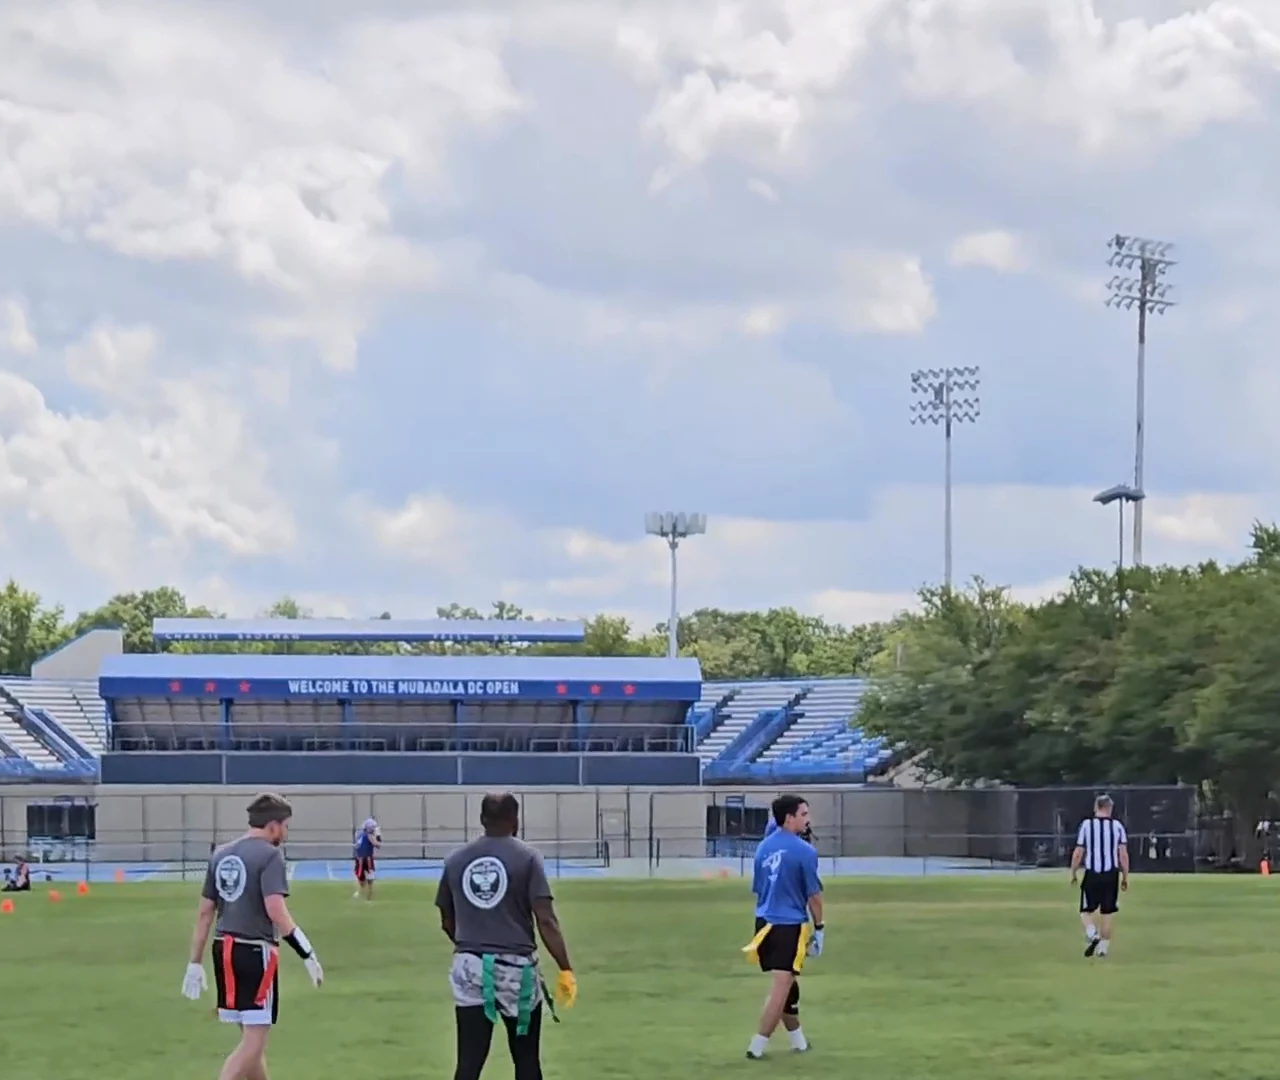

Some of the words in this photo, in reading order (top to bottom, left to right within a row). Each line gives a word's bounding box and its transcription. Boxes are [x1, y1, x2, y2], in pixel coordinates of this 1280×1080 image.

[288, 680, 349, 694] WELCOME
[351, 680, 368, 694] TO
[371, 681, 395, 694] THE
[398, 681, 465, 694] MUBADALA
[467, 681, 484, 694] DC
[486, 681, 519, 694] OPEN
